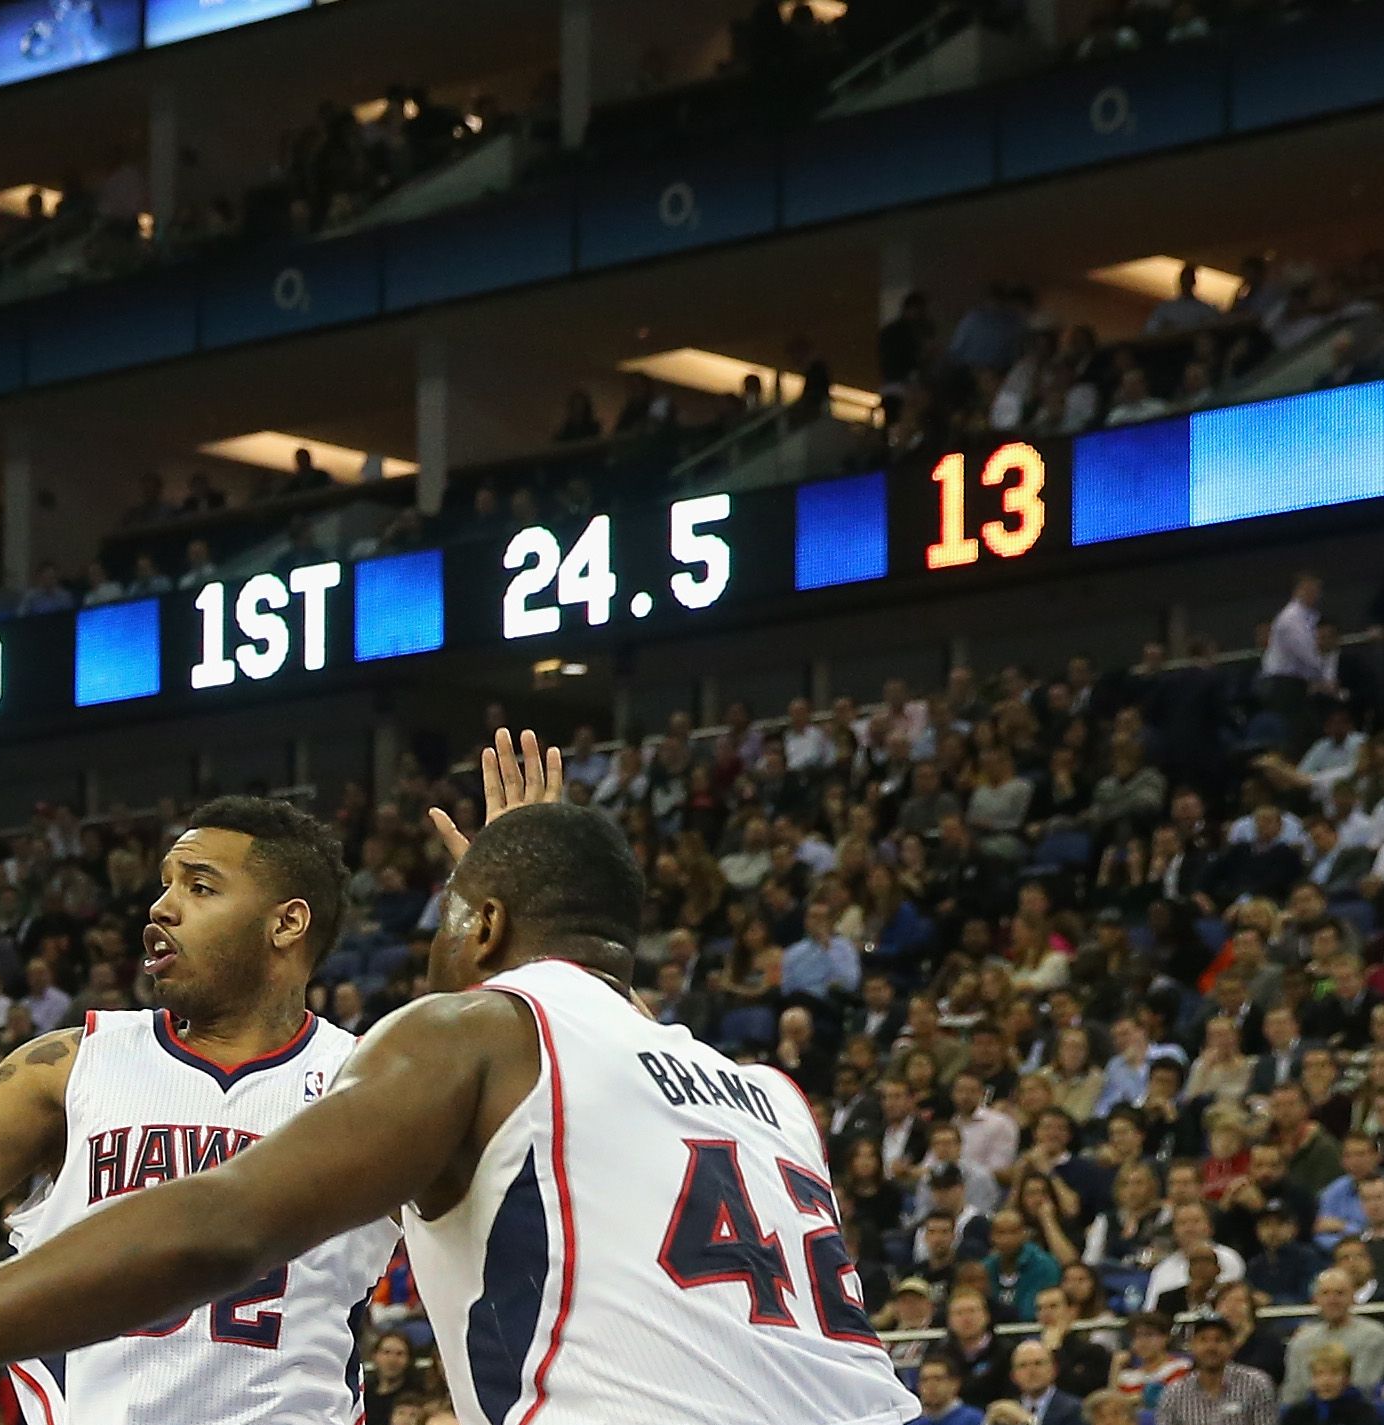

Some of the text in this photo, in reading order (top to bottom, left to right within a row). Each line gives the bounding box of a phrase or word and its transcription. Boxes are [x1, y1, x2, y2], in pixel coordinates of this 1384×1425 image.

[502, 493, 732, 640] 24.5
[926, 441, 1046, 570] 13
[190, 561, 341, 690] 1ST
[637, 1051, 782, 1130] BRAND
[657, 1138, 884, 1348] 42
